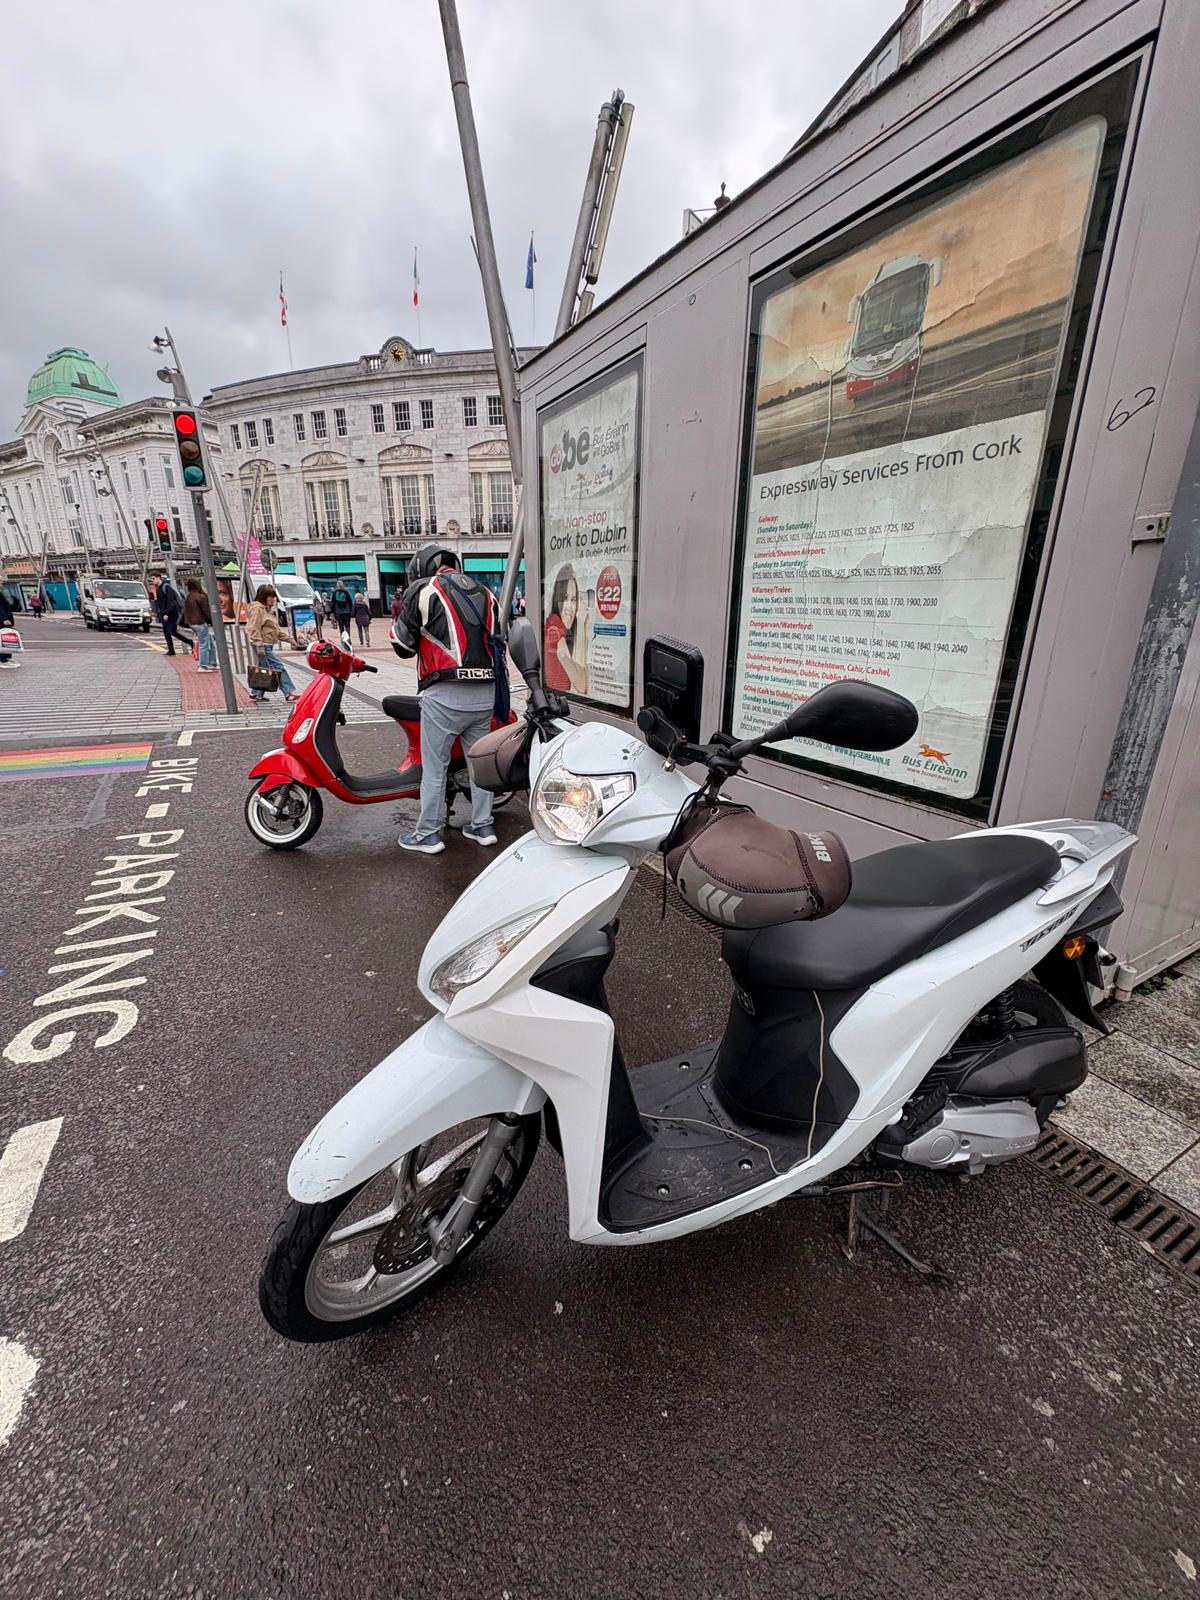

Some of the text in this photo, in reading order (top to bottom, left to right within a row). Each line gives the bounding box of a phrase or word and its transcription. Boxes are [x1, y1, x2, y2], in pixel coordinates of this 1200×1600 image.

[1106, 386, 1156, 431] 62
[760, 434, 1022, 500] Expressway Services From Cork
[566, 511, 608, 528] Non-stop
[901, 522, 915, 531] 1825
[550, 524, 627, 550] Cork to Dublin
[586, 548, 603, 558] Dublin
[604, 544, 626, 556] Airport
[802, 548, 826, 556] Airport:
[863, 568, 876, 577] 1625,
[878, 568, 892, 576] 1725,
[894, 567, 908, 576] 1825,
[910, 566, 925, 576] 1925,
[926, 566, 942, 575] 2055
[598, 586, 620, 601] €22
[874, 598, 889, 606] 1630,
[890, 598, 904, 607] 1730,
[906, 598, 921, 607] 1900,
[923, 598, 938, 606] 2030
[877, 610, 891, 618] 2030
[749, 620, 814, 630] Dungarvan/Waterford:
[885, 639, 899, 649] 1640,
[900, 641, 915, 650] 1740,
[917, 642, 932, 651] 1840,
[934, 643, 950, 653] 1940,
[951, 644, 968, 654] 2040
[872, 651, 885, 660] 1840,
[887, 652, 900, 660] 2040
[800, 669, 820, 678] Dublin,
[805, 660, 845, 671] Mitchelstown,
[866, 667, 891, 677] Cashel,
[902, 755, 968, 779] Bus Éireann
[2, 757, 199, 1064] BIKE PARKING
